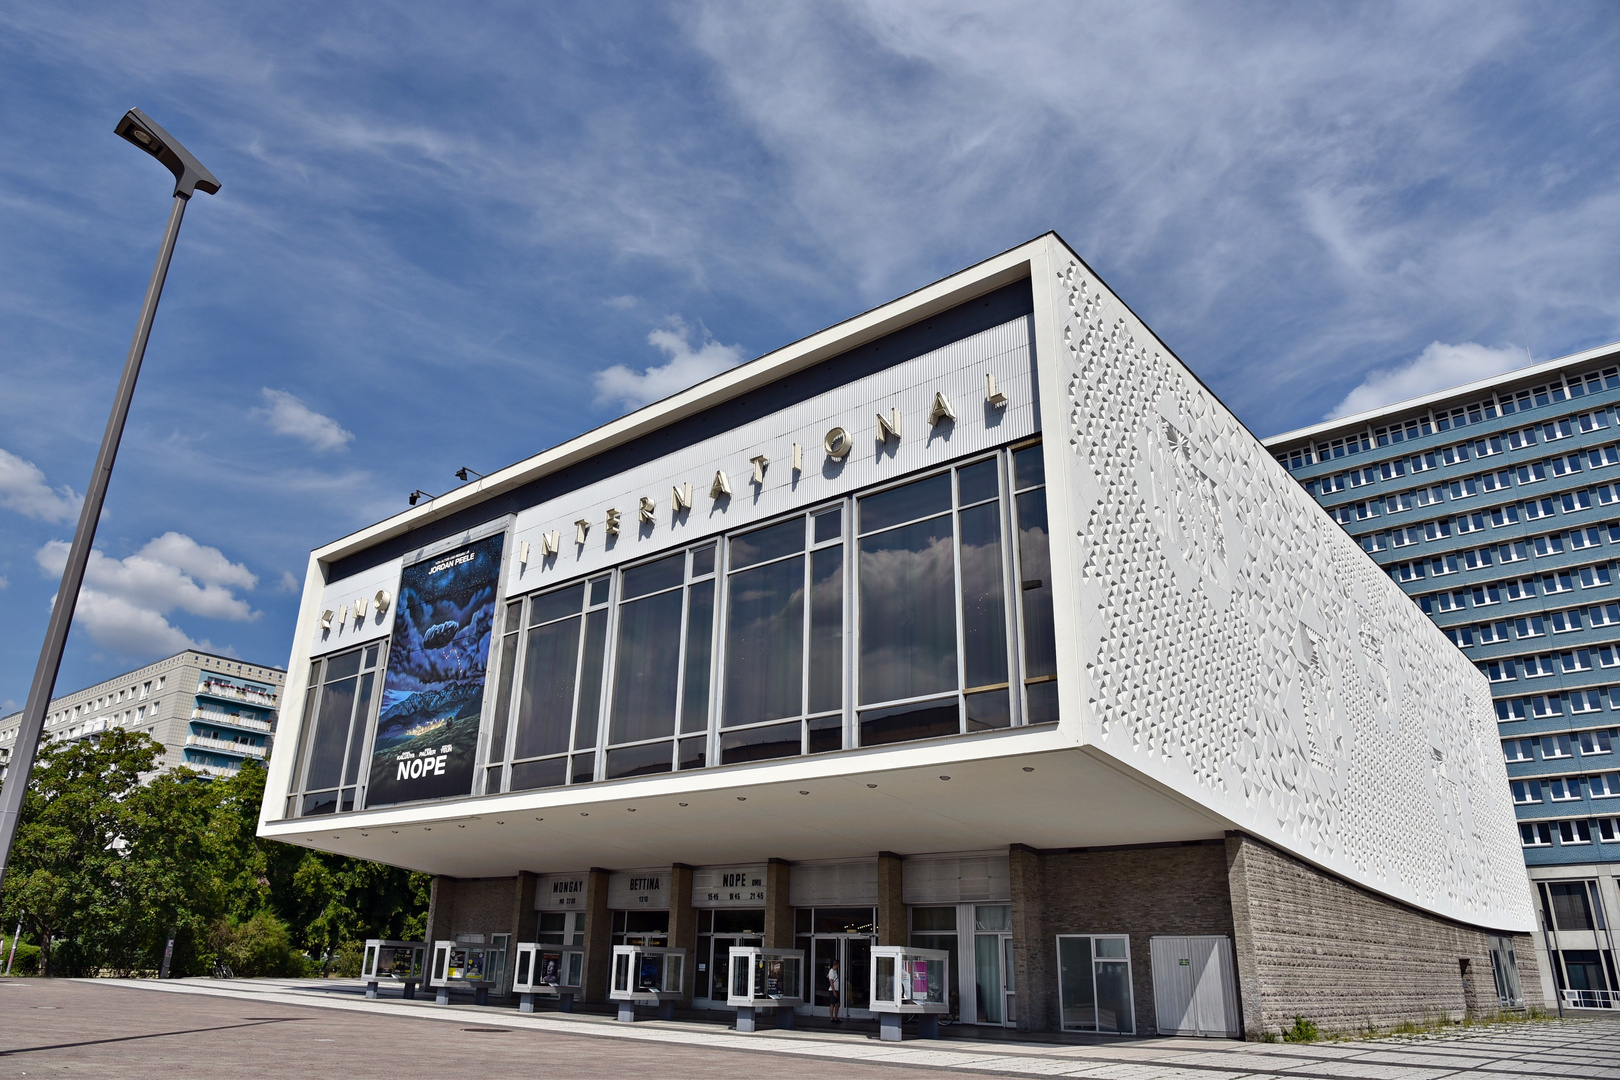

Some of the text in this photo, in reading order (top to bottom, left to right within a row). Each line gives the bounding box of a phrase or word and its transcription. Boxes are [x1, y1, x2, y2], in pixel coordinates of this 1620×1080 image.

[320, 373, 1008, 630] KINO INTERNATIONAL
[428, 560, 454, 575] JORDAN
[454, 552, 475, 566] PEELE
[396, 755, 448, 781] NOPE
[552, 880, 584, 893] MONGAY
[629, 878, 660, 891] BETTINA
[722, 873, 746, 887] NOPE
